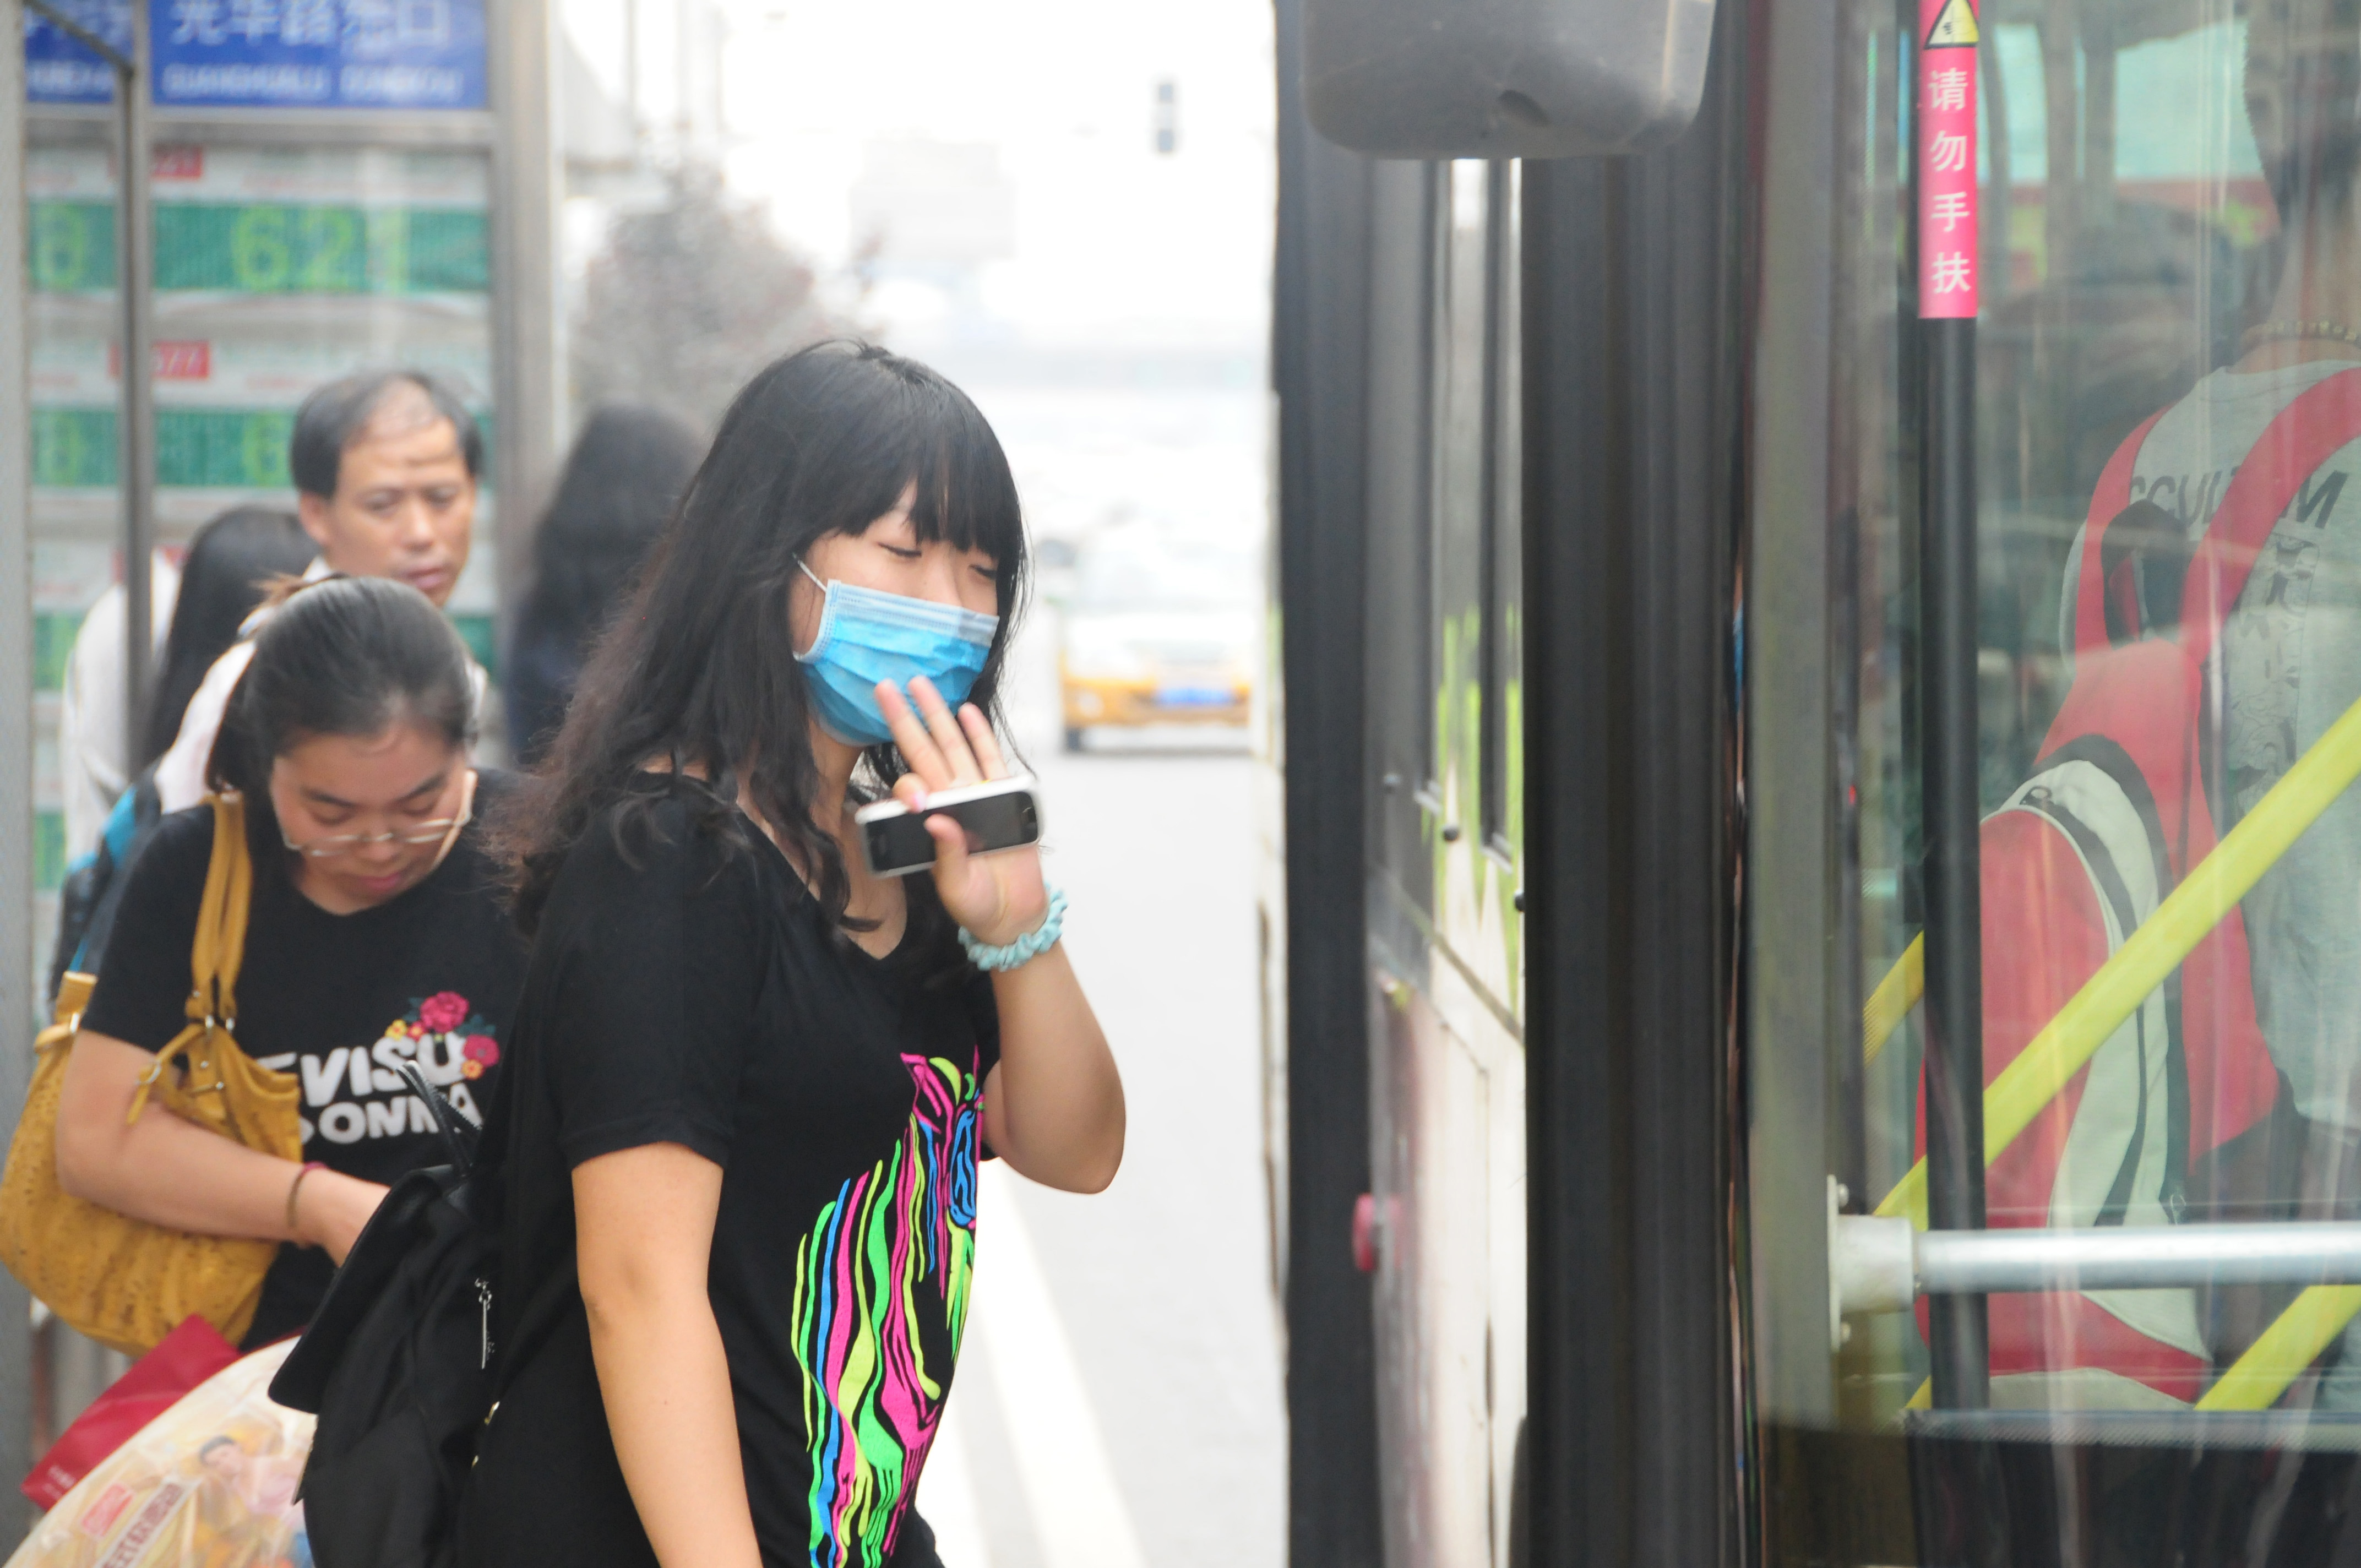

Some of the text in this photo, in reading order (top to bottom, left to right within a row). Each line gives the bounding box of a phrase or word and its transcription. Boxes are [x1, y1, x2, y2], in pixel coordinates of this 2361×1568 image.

[1927, 66, 1972, 295] 请勿手扶
[257, 1031, 468, 1108] VISU
[299, 1082, 485, 1144] ONNA
